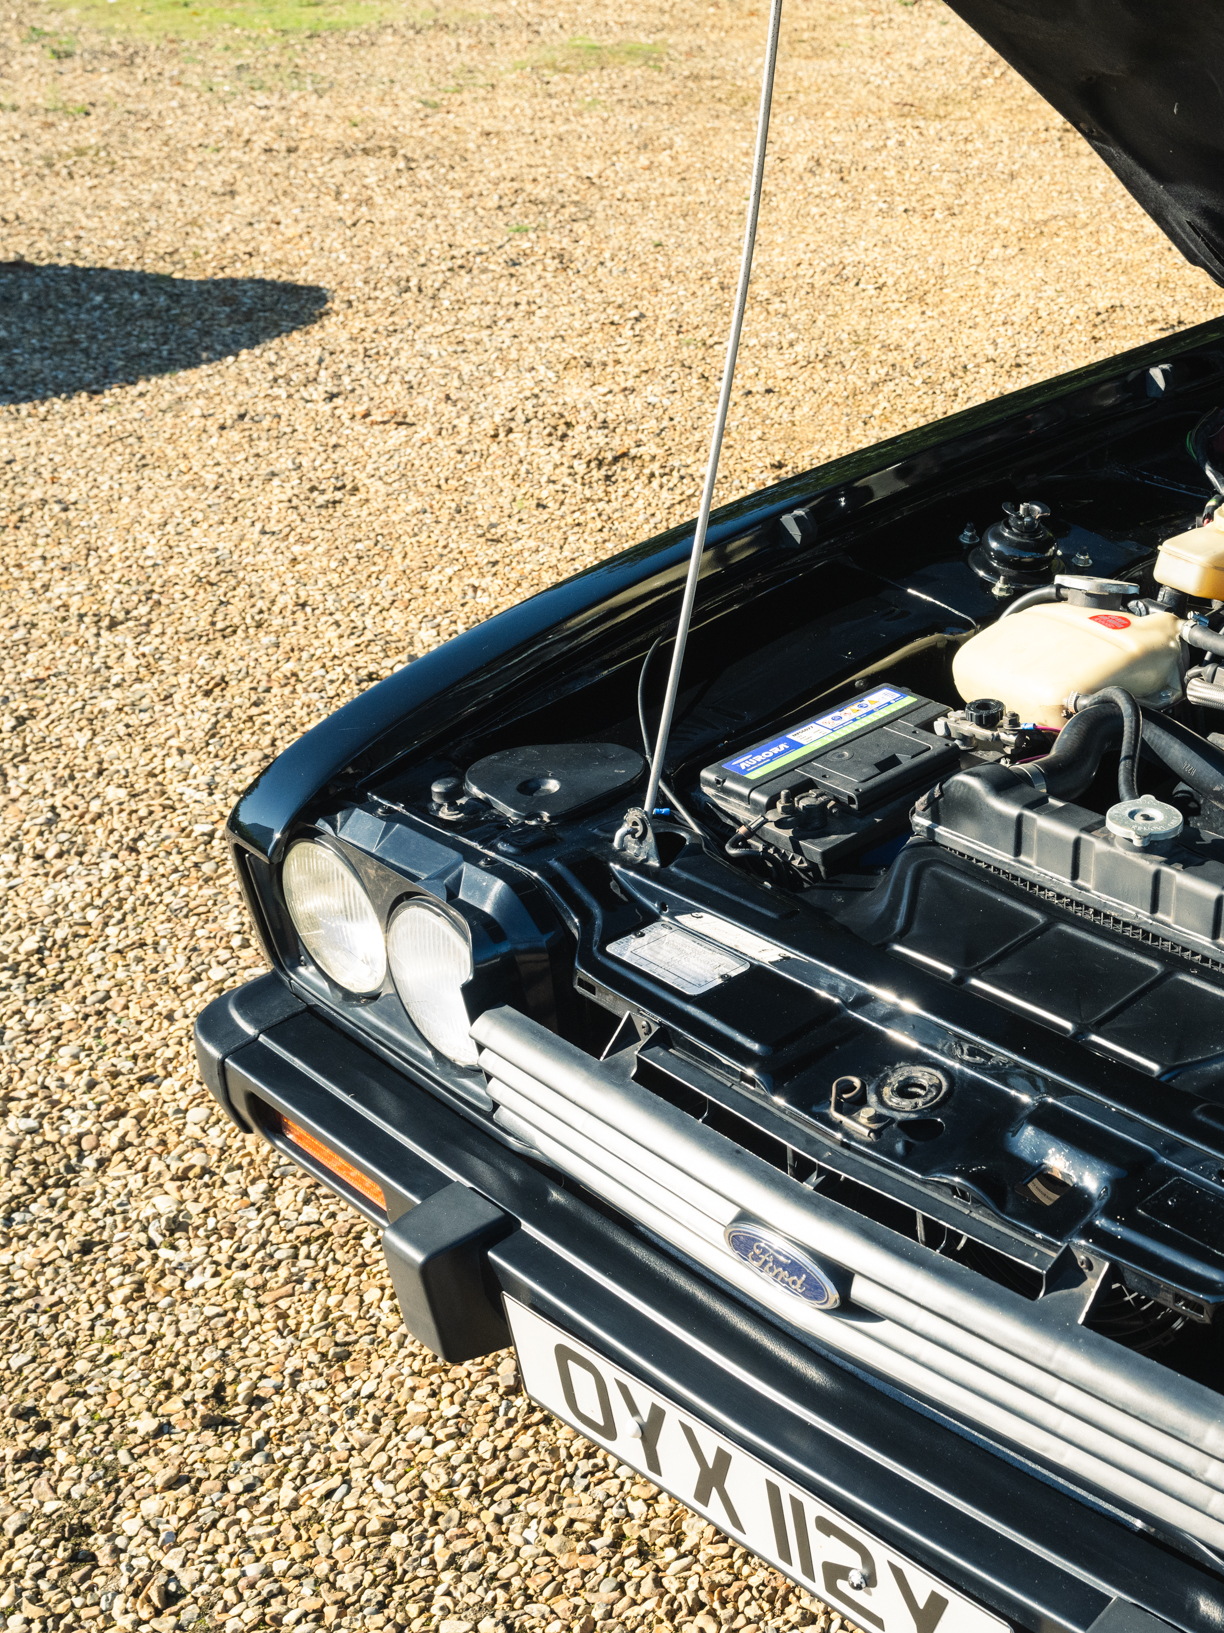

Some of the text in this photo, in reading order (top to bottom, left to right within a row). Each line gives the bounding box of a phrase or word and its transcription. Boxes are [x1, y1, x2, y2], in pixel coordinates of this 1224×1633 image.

[739, 743, 790, 770] AURORA
[748, 1242, 806, 1297] Ford
[553, 1343, 950, 1633] OYX 112Y
